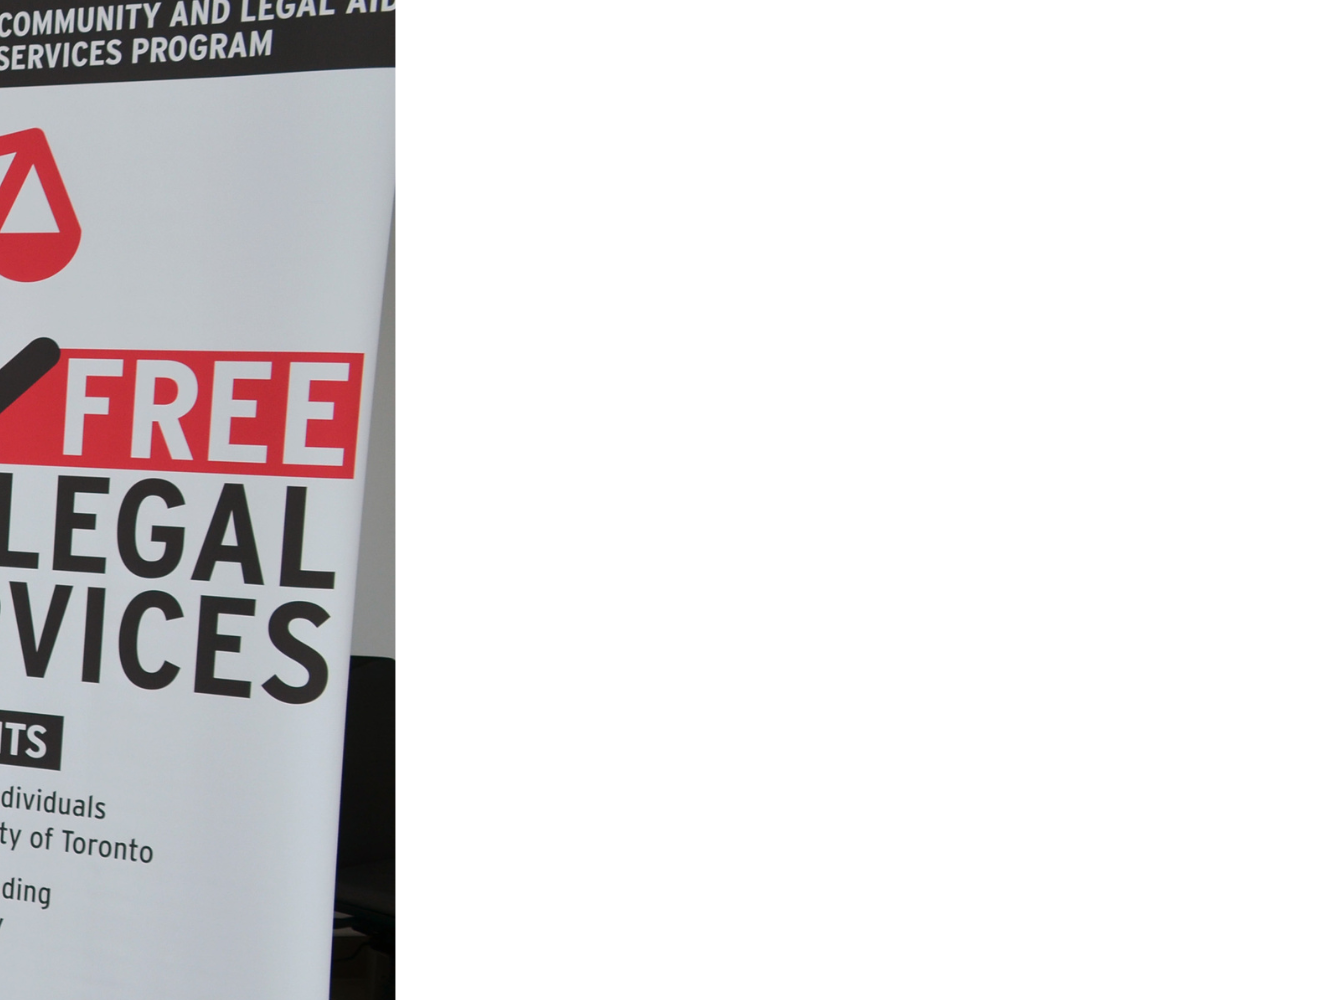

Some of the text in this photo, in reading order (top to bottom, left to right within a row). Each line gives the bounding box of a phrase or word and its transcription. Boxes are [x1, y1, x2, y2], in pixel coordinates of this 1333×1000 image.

[169, 0, 231, 27] AND
[131, 30, 274, 64] PROGRAM
[62, 358, 351, 467] FREE
[29, 827, 55, 850] of
[61, 830, 154, 864] Toronto
